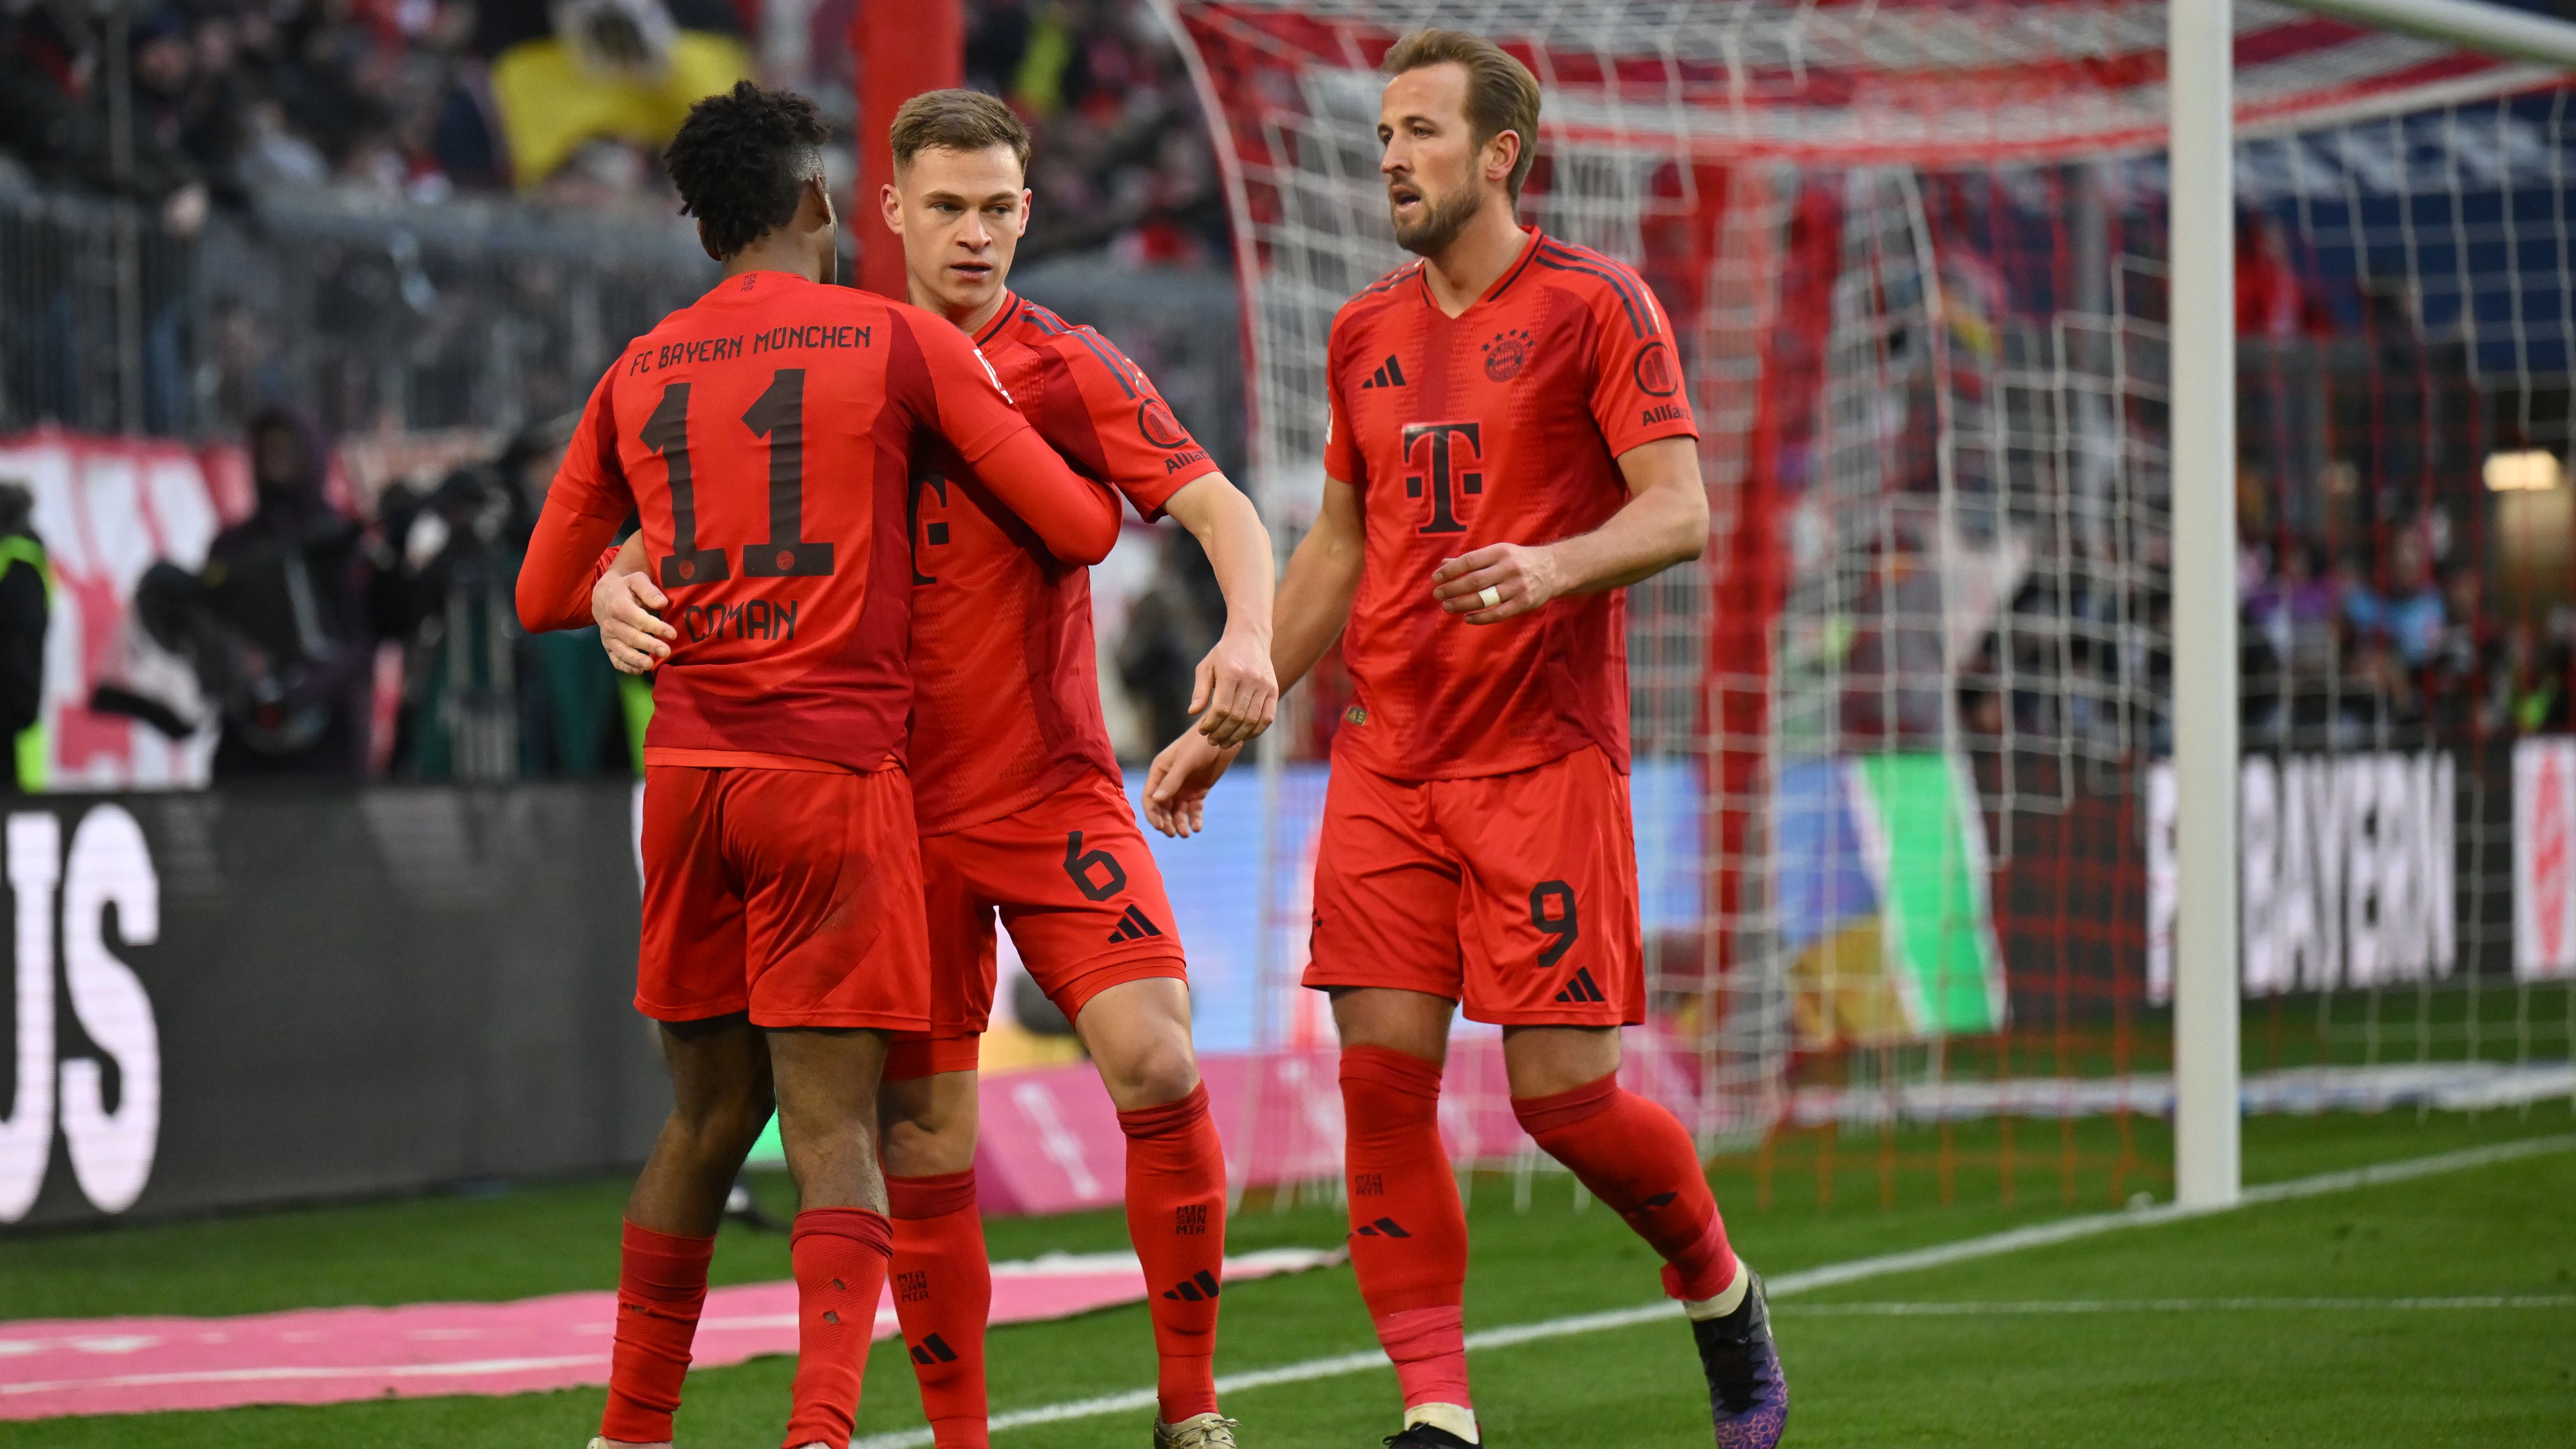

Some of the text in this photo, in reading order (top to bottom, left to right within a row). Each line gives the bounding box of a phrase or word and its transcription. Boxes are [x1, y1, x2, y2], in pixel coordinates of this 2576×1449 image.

[630, 326, 871, 376] FC BAYERN MÜNCHEN
[1642, 404, 1690, 426] Allian
[1164, 450, 1209, 475] Allian
[639, 369, 834, 588] 11
[685, 599, 798, 643] COMAN
[1063, 831, 1127, 901] 6
[1529, 880, 1578, 968] 9
[1177, 1205, 1207, 1215] MIA
[1177, 1215, 1206, 1225] SAN
[1176, 1224, 1205, 1235] MIA
[898, 1270, 925, 1283] MIA
[902, 1290, 929, 1302] MIA
